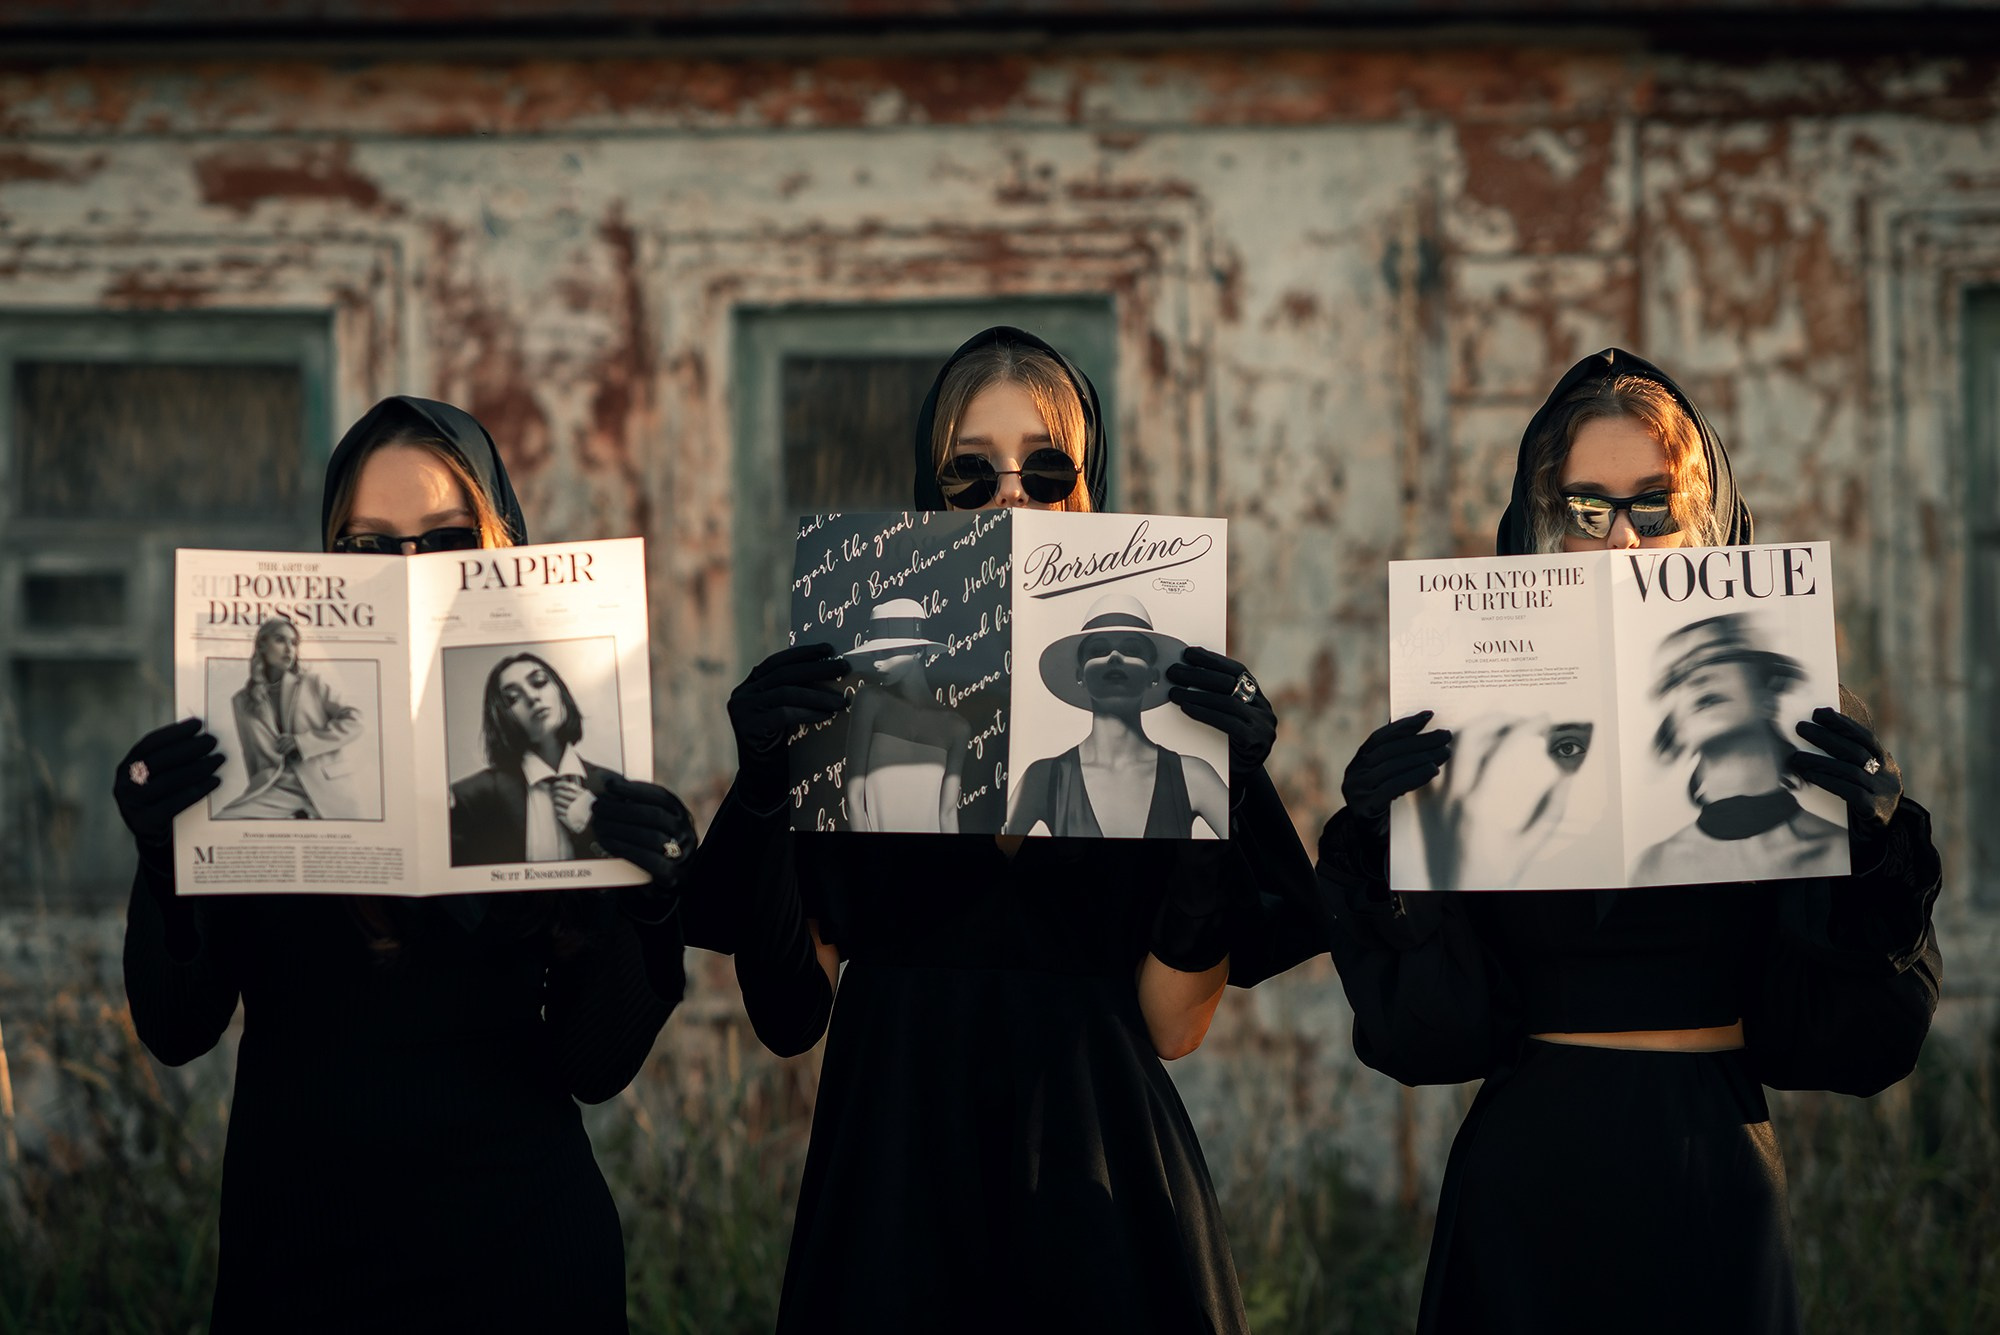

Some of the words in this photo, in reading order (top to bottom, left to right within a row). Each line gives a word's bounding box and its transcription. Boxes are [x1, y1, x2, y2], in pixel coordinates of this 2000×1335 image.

[841, 533, 868, 562] the
[1023, 520, 1213, 592] Borsalino
[458, 552, 595, 591] PAPER
[1419, 573, 1478, 593] LOOK
[1487, 570, 1537, 590] INTO
[1542, 566, 1586, 588] THE
[1624, 548, 1816, 602] VOGUE
[232, 574, 347, 600] POWER
[818, 582, 862, 628] loyal
[867, 550, 946, 600] Borsalino
[1454, 590, 1554, 612] FURTURE
[208, 600, 376, 628] DRESSING
[920, 590, 949, 618] the
[948, 612, 990, 656] based
[1473, 640, 1534, 654] SOMNIA
